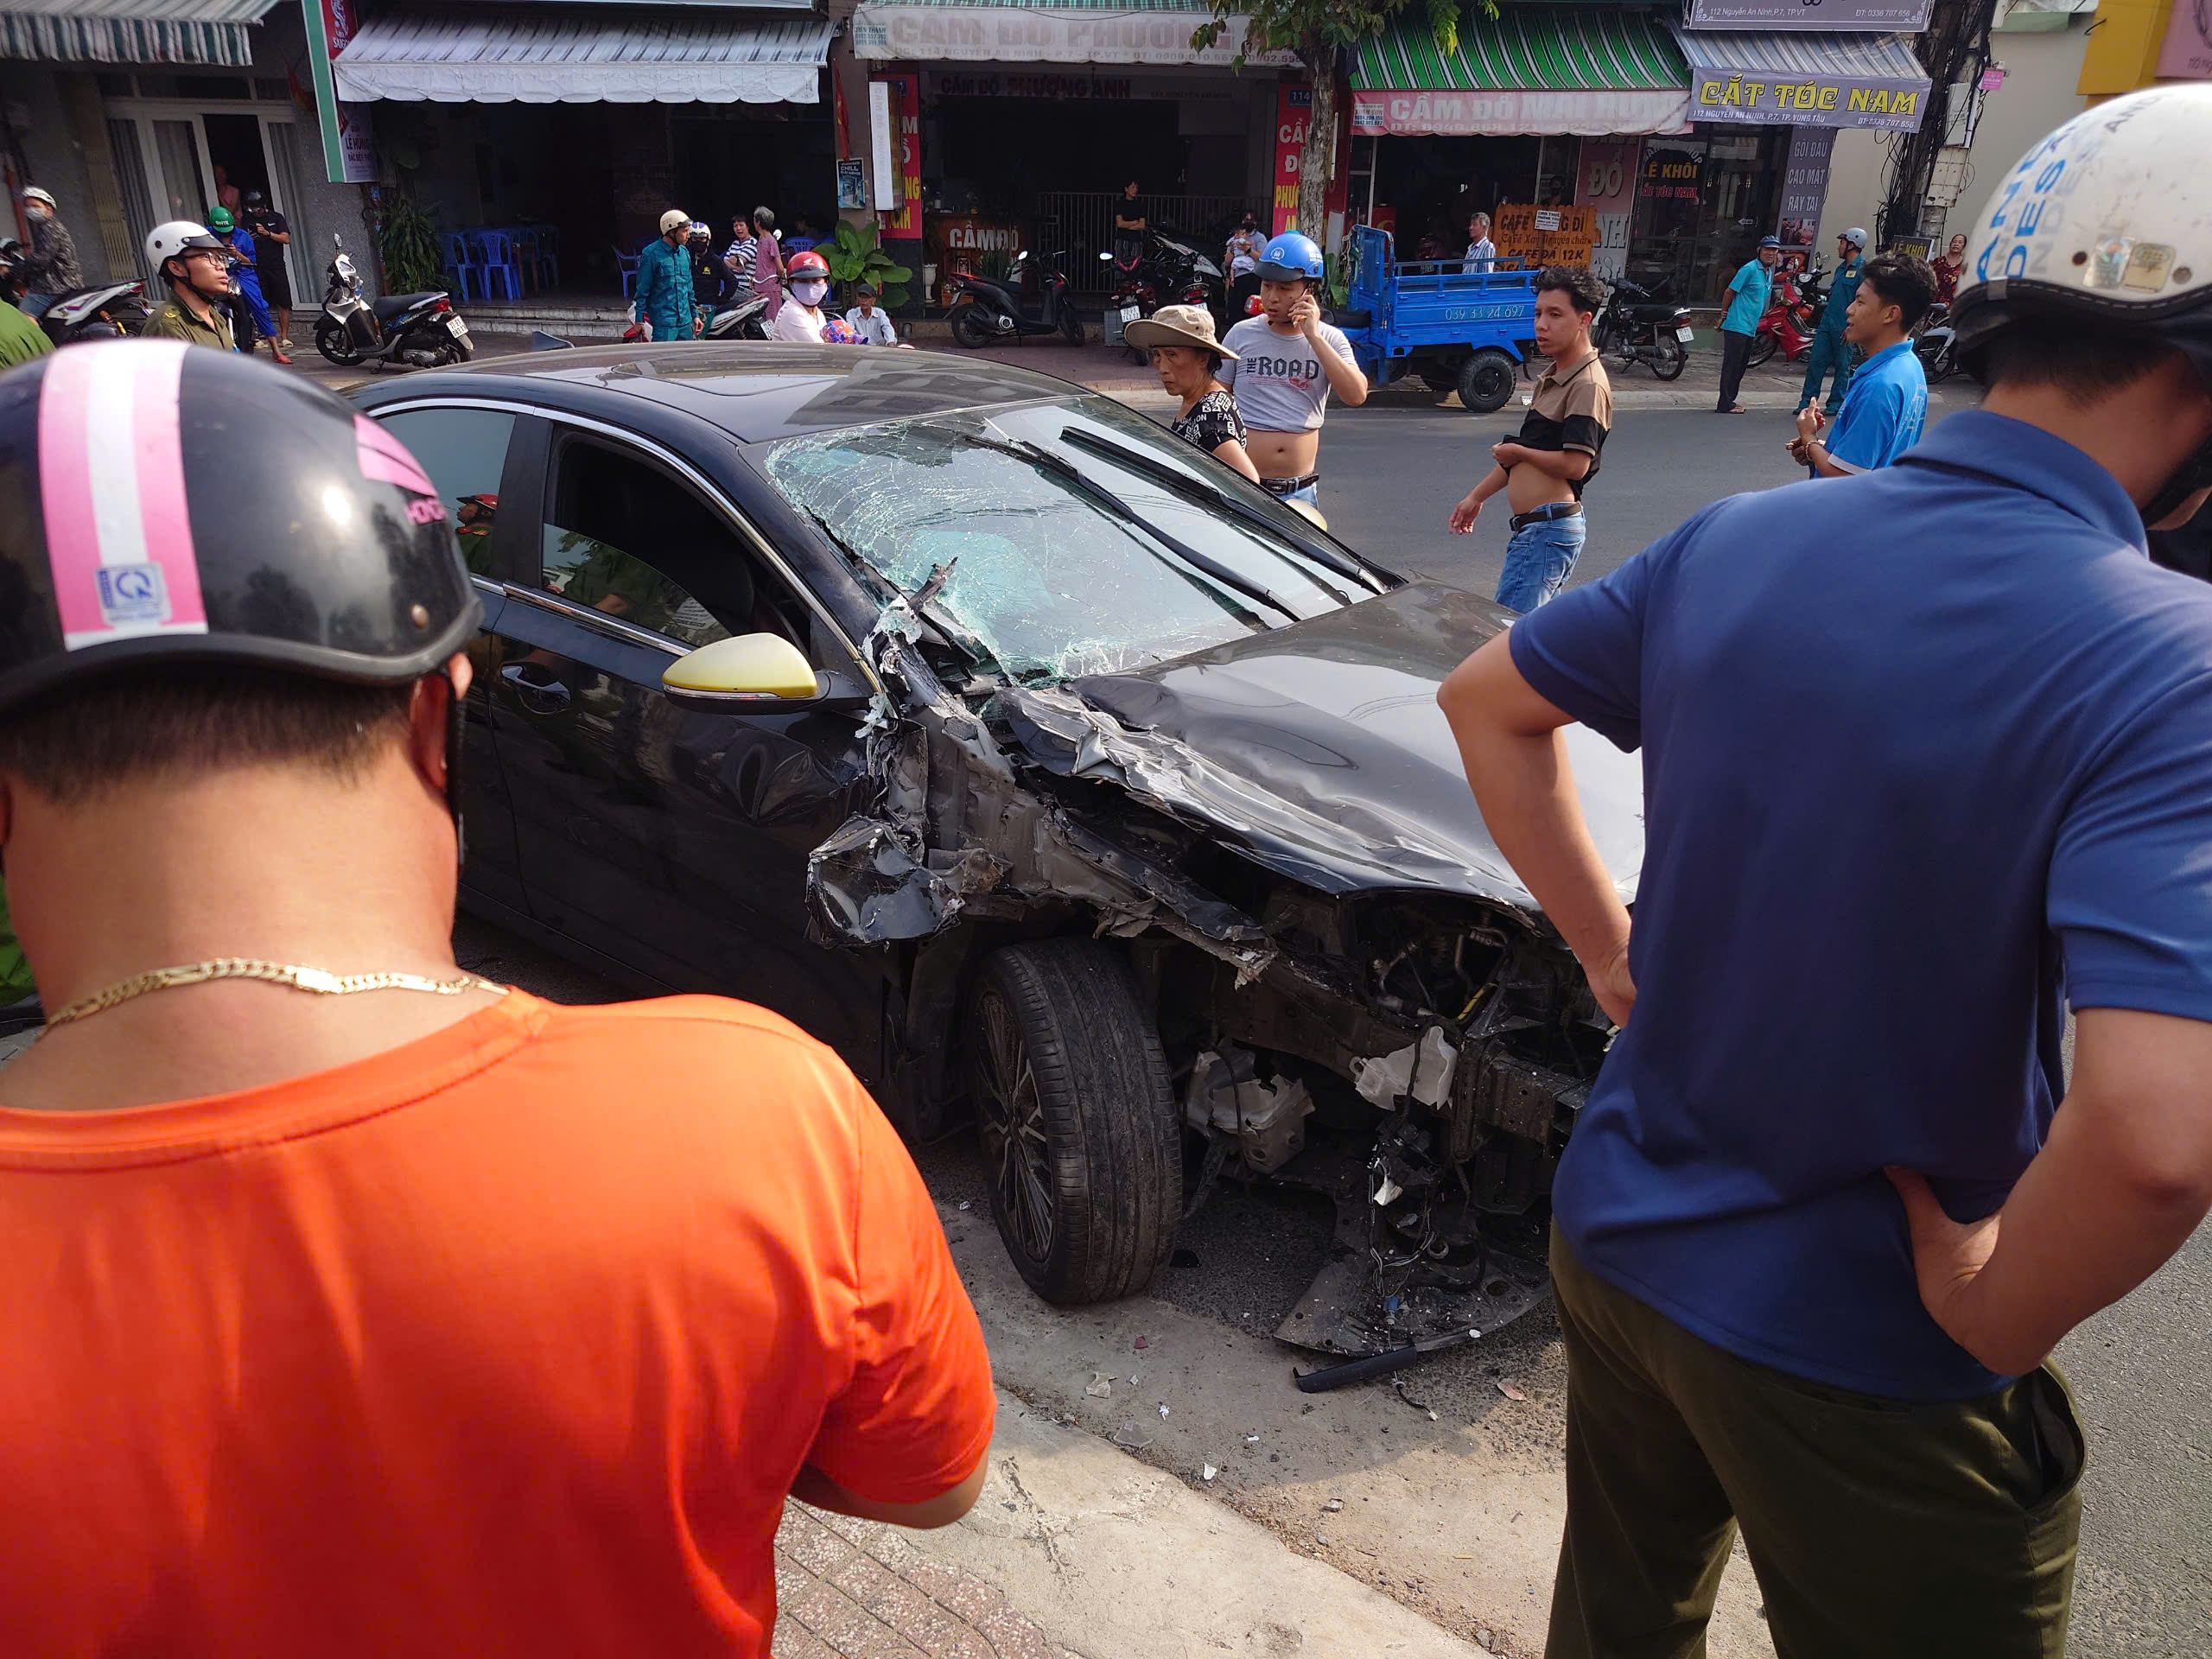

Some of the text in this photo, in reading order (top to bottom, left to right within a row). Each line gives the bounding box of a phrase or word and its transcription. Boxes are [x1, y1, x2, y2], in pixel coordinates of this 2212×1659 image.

[1292, 92, 1311, 100] 114
[1700, 73, 1919, 116] CẮT TÓC NAM
[1687, 146, 1702, 164] HOP
[1794, 138, 1809, 161] GỘI
[1285, 154, 1300, 173] Đ
[1661, 163, 1698, 179] KHÔI
[1788, 168, 1805, 188] CẠO
[1656, 185, 1673, 198] TÓC
[1675, 186, 1698, 199] NAM
[1788, 193, 1819, 212] RÁY TAI
[950, 220, 995, 251] CẦM
[1563, 249, 1585, 260] 12K
[1446, 304, 1525, 321] 039 33 24 697
[1247, 356, 1319, 379] THE ROAD
